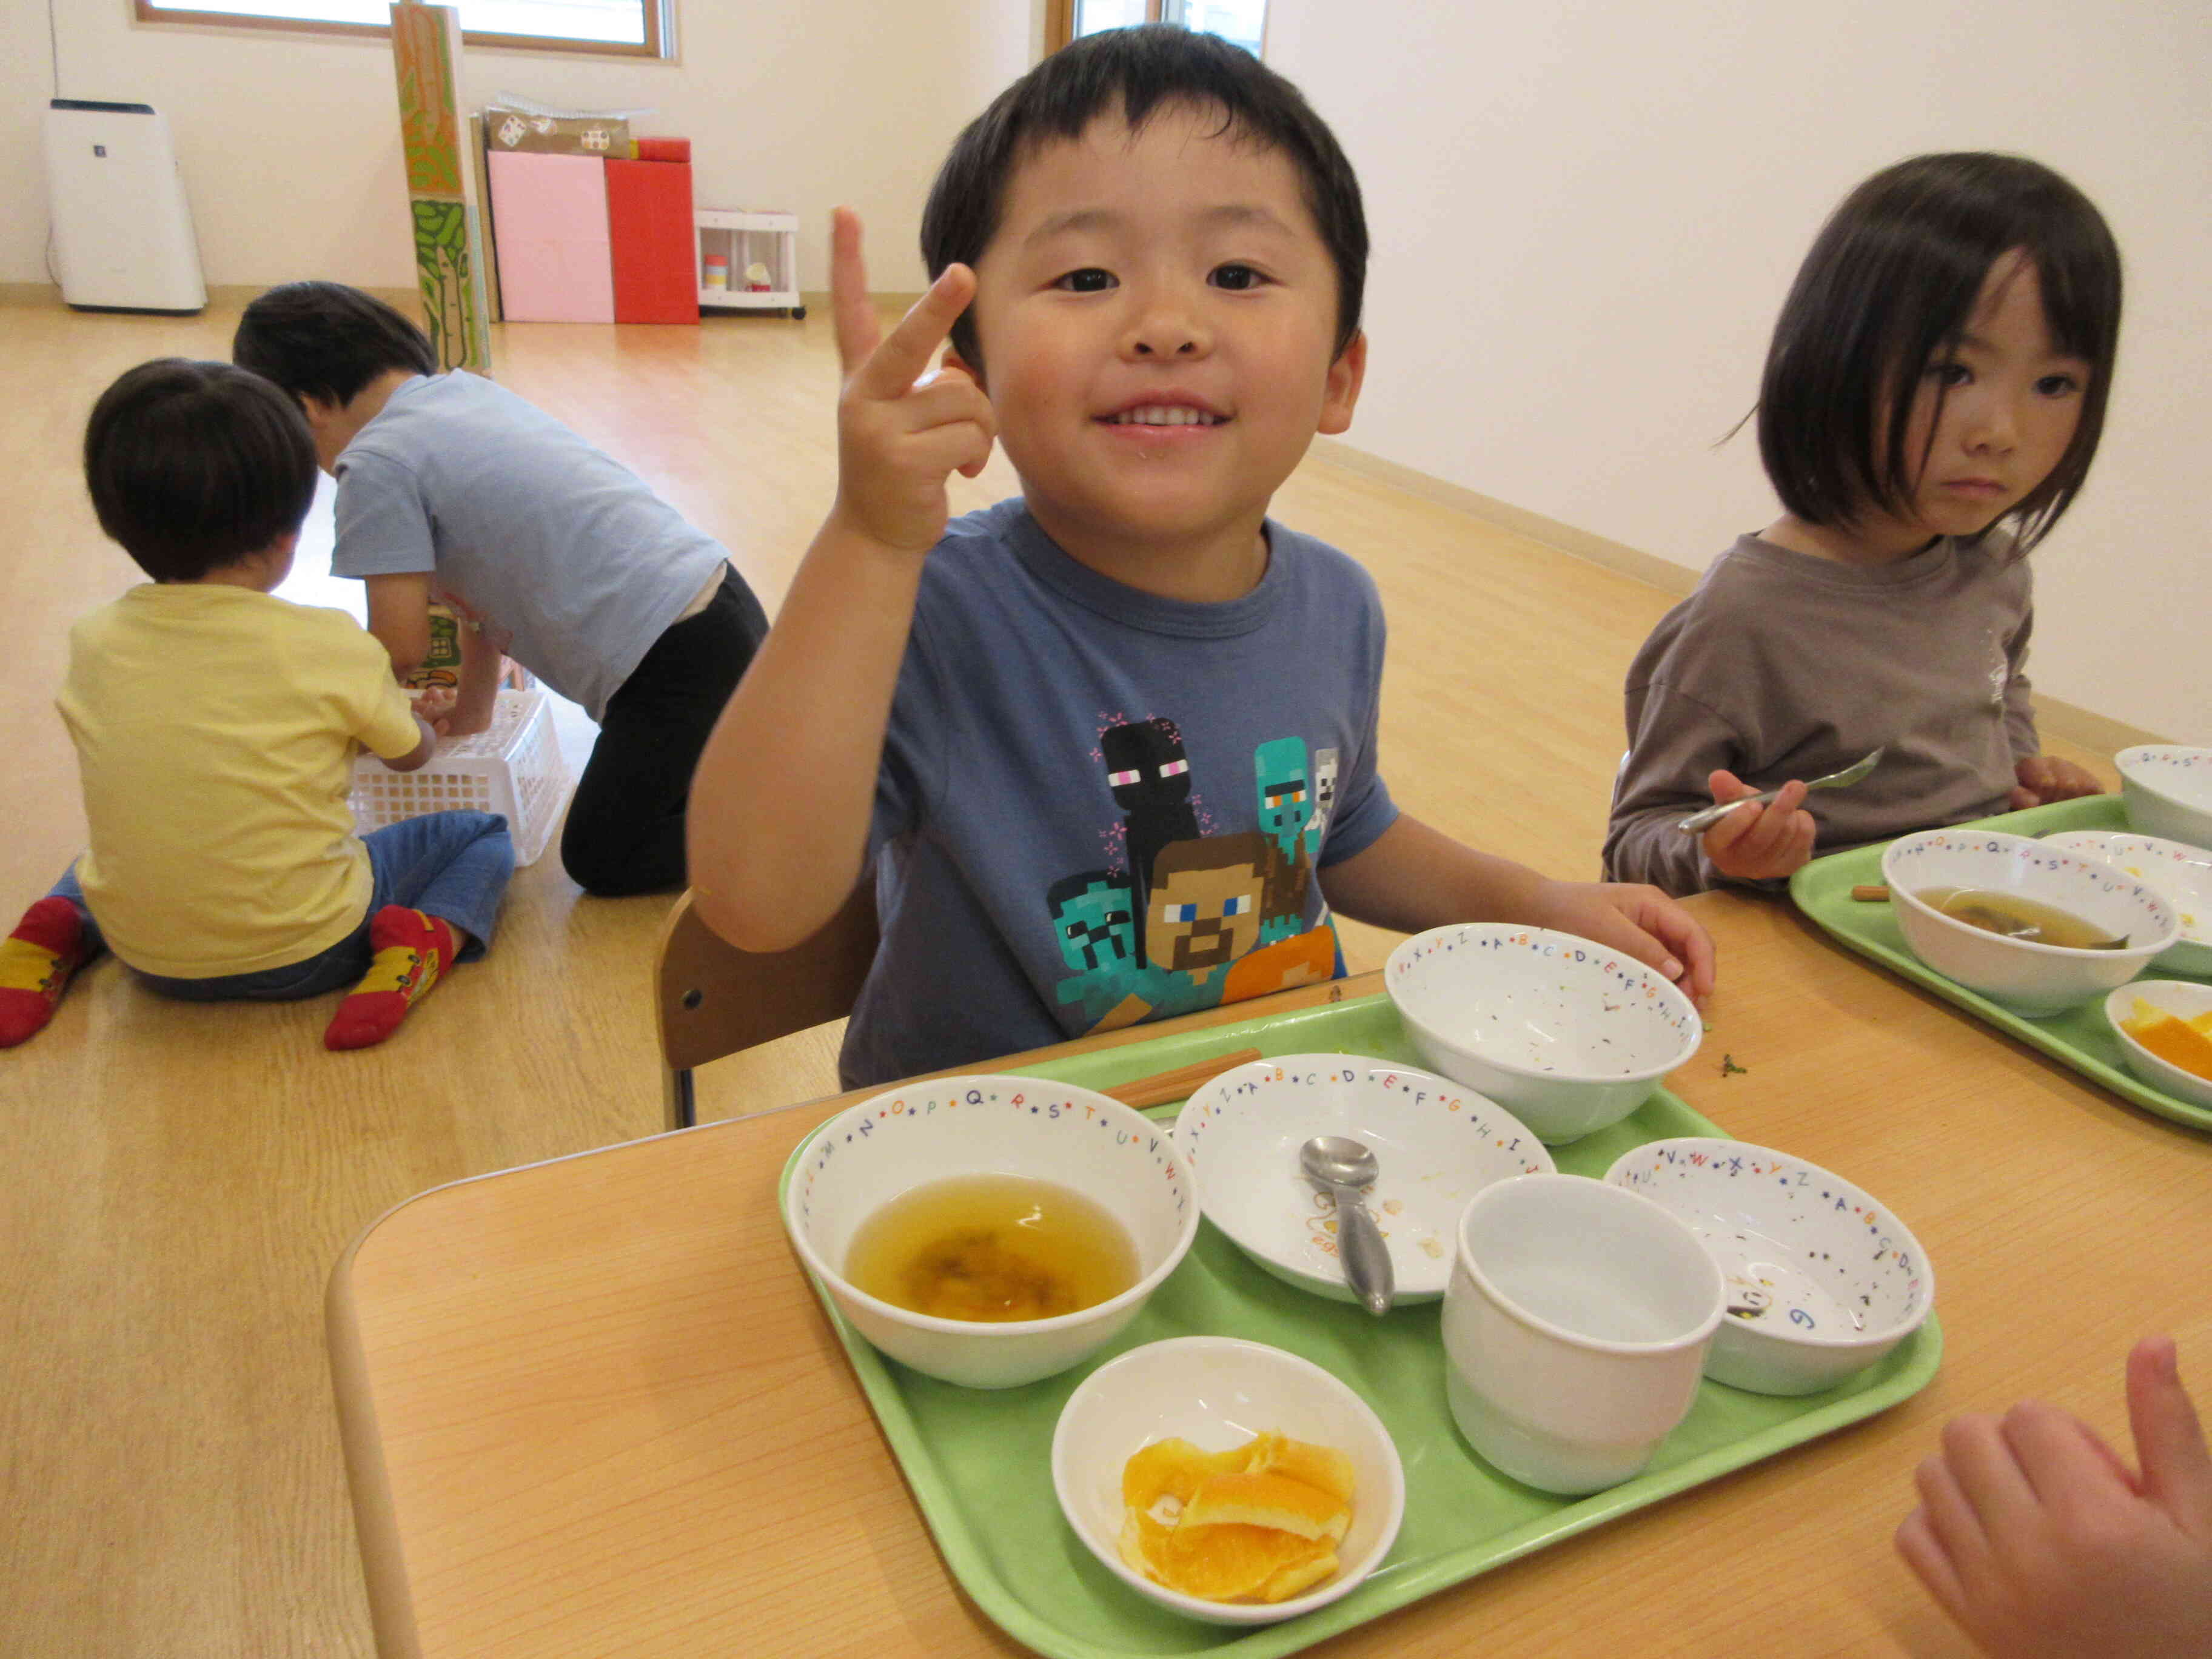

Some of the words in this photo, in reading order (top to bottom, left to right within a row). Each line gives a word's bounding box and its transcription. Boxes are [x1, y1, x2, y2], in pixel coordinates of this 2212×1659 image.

[1936, 836, 1945, 846] O
[1986, 841, 1999, 853] Q
[2048, 859, 2058, 871] S
[1517, 933, 1529, 947] B
[1543, 946, 1554, 956] C
[1574, 950, 1586, 962] D
[1604, 960, 1618, 973] E
[1624, 978, 1636, 991] F
[891, 1100, 905, 1115] O
[927, 1101, 937, 1115] P
[966, 1090, 984, 1105] Q
[1010, 1093, 1025, 1109] R
[1048, 1104, 1061, 1119] S
[1085, 1105, 1096, 1121] T
[1116, 1130, 1128, 1145] U
[1149, 1137, 1159, 1153] V
[1248, 1082, 1259, 1095] A
[1275, 1067, 1285, 1082] B
[1306, 1073, 1317, 1085] C
[1342, 1069, 1355, 1082] D
[1383, 1074, 1398, 1089] E
[1415, 1091, 1427, 1106] F
[1448, 1098, 1461, 1112] G
[1475, 1122, 1492, 1139] H
[1508, 1138, 1521, 1151] I
[1667, 1150, 1676, 1164] V
[1692, 1151, 1709, 1167] W
[1729, 1156, 1743, 1171] X
[1768, 1161, 1783, 1175] Y
[1796, 1171, 1810, 1187] Z
[1835, 1197, 1847, 1212] A
